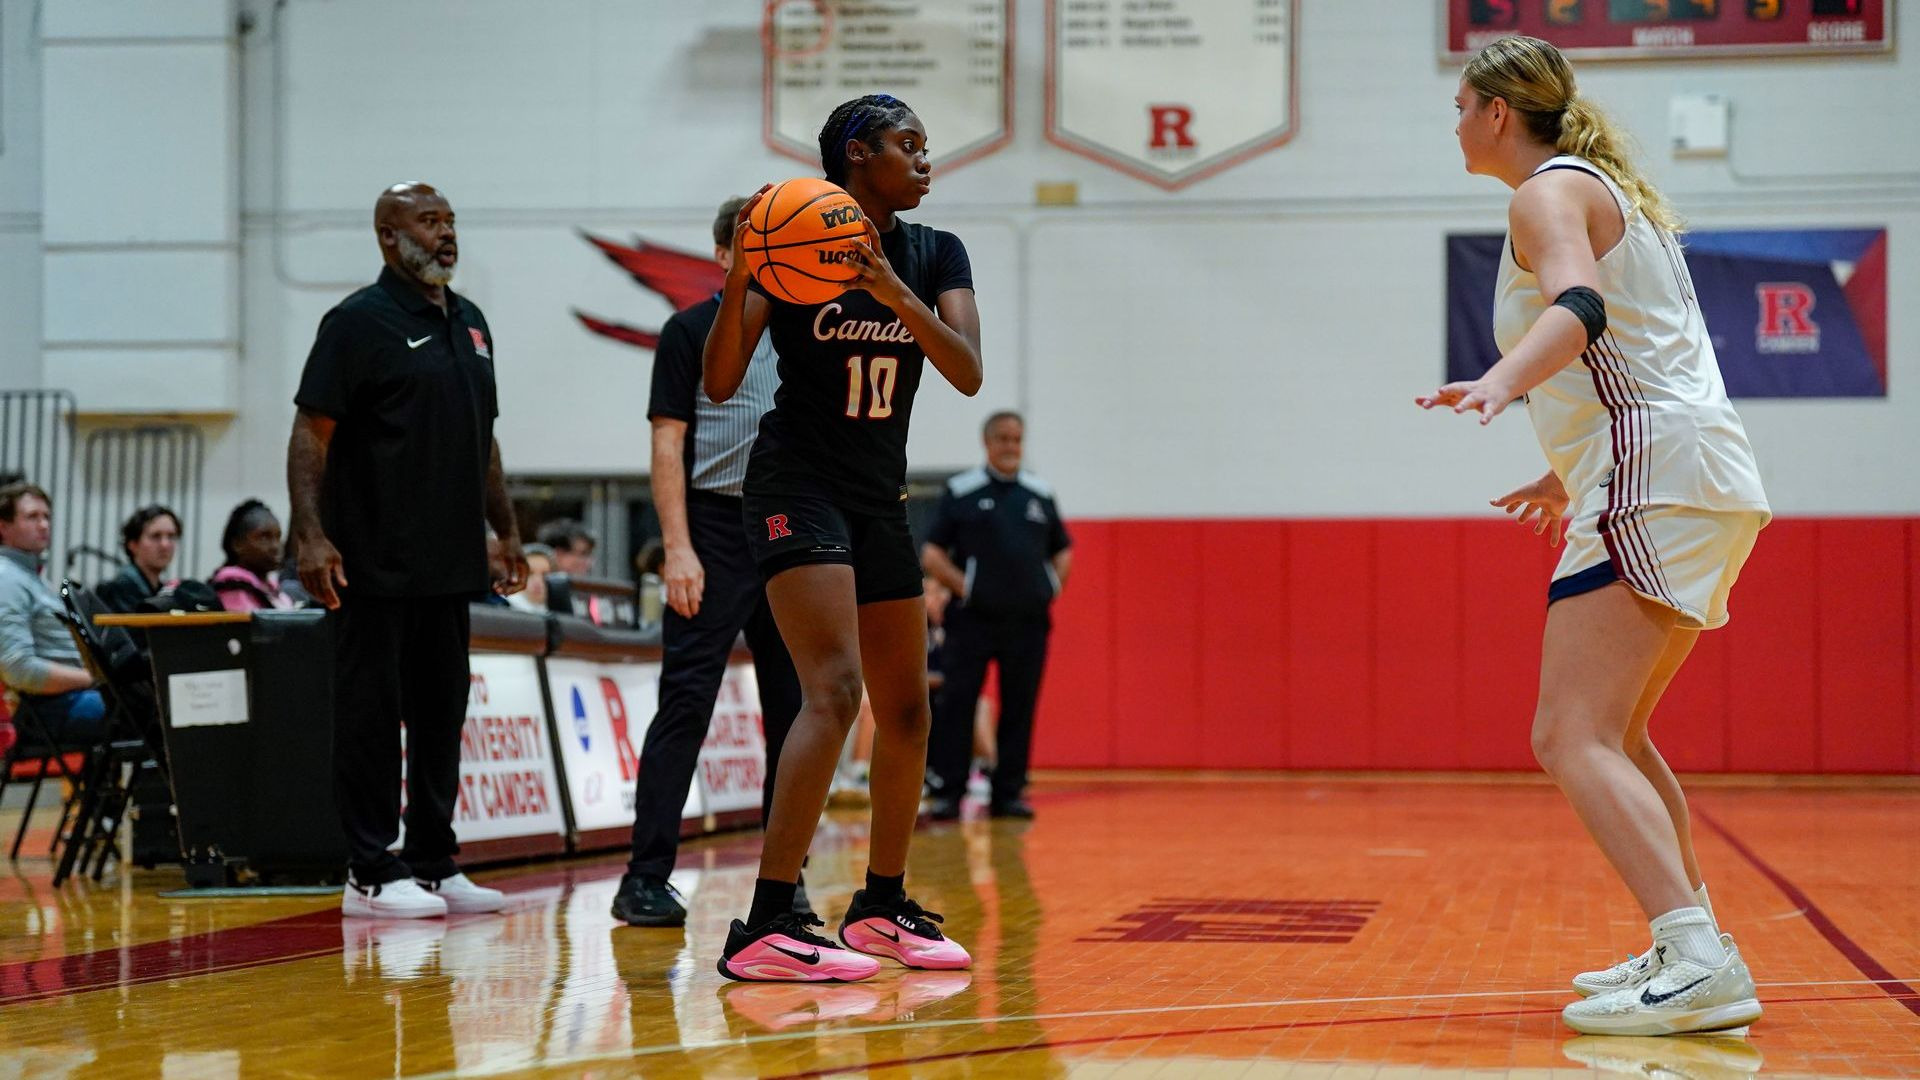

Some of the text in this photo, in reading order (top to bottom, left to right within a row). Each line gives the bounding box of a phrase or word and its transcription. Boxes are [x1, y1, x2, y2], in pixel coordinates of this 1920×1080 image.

[1149, 105, 1195, 149] R
[813, 302, 915, 343] Camde
[1755, 282, 1820, 336] R
[846, 355, 898, 418] 10
[766, 514, 792, 541] R
[460, 717, 542, 762] NIVERSITY
[480, 771, 549, 818] CAMDEN
